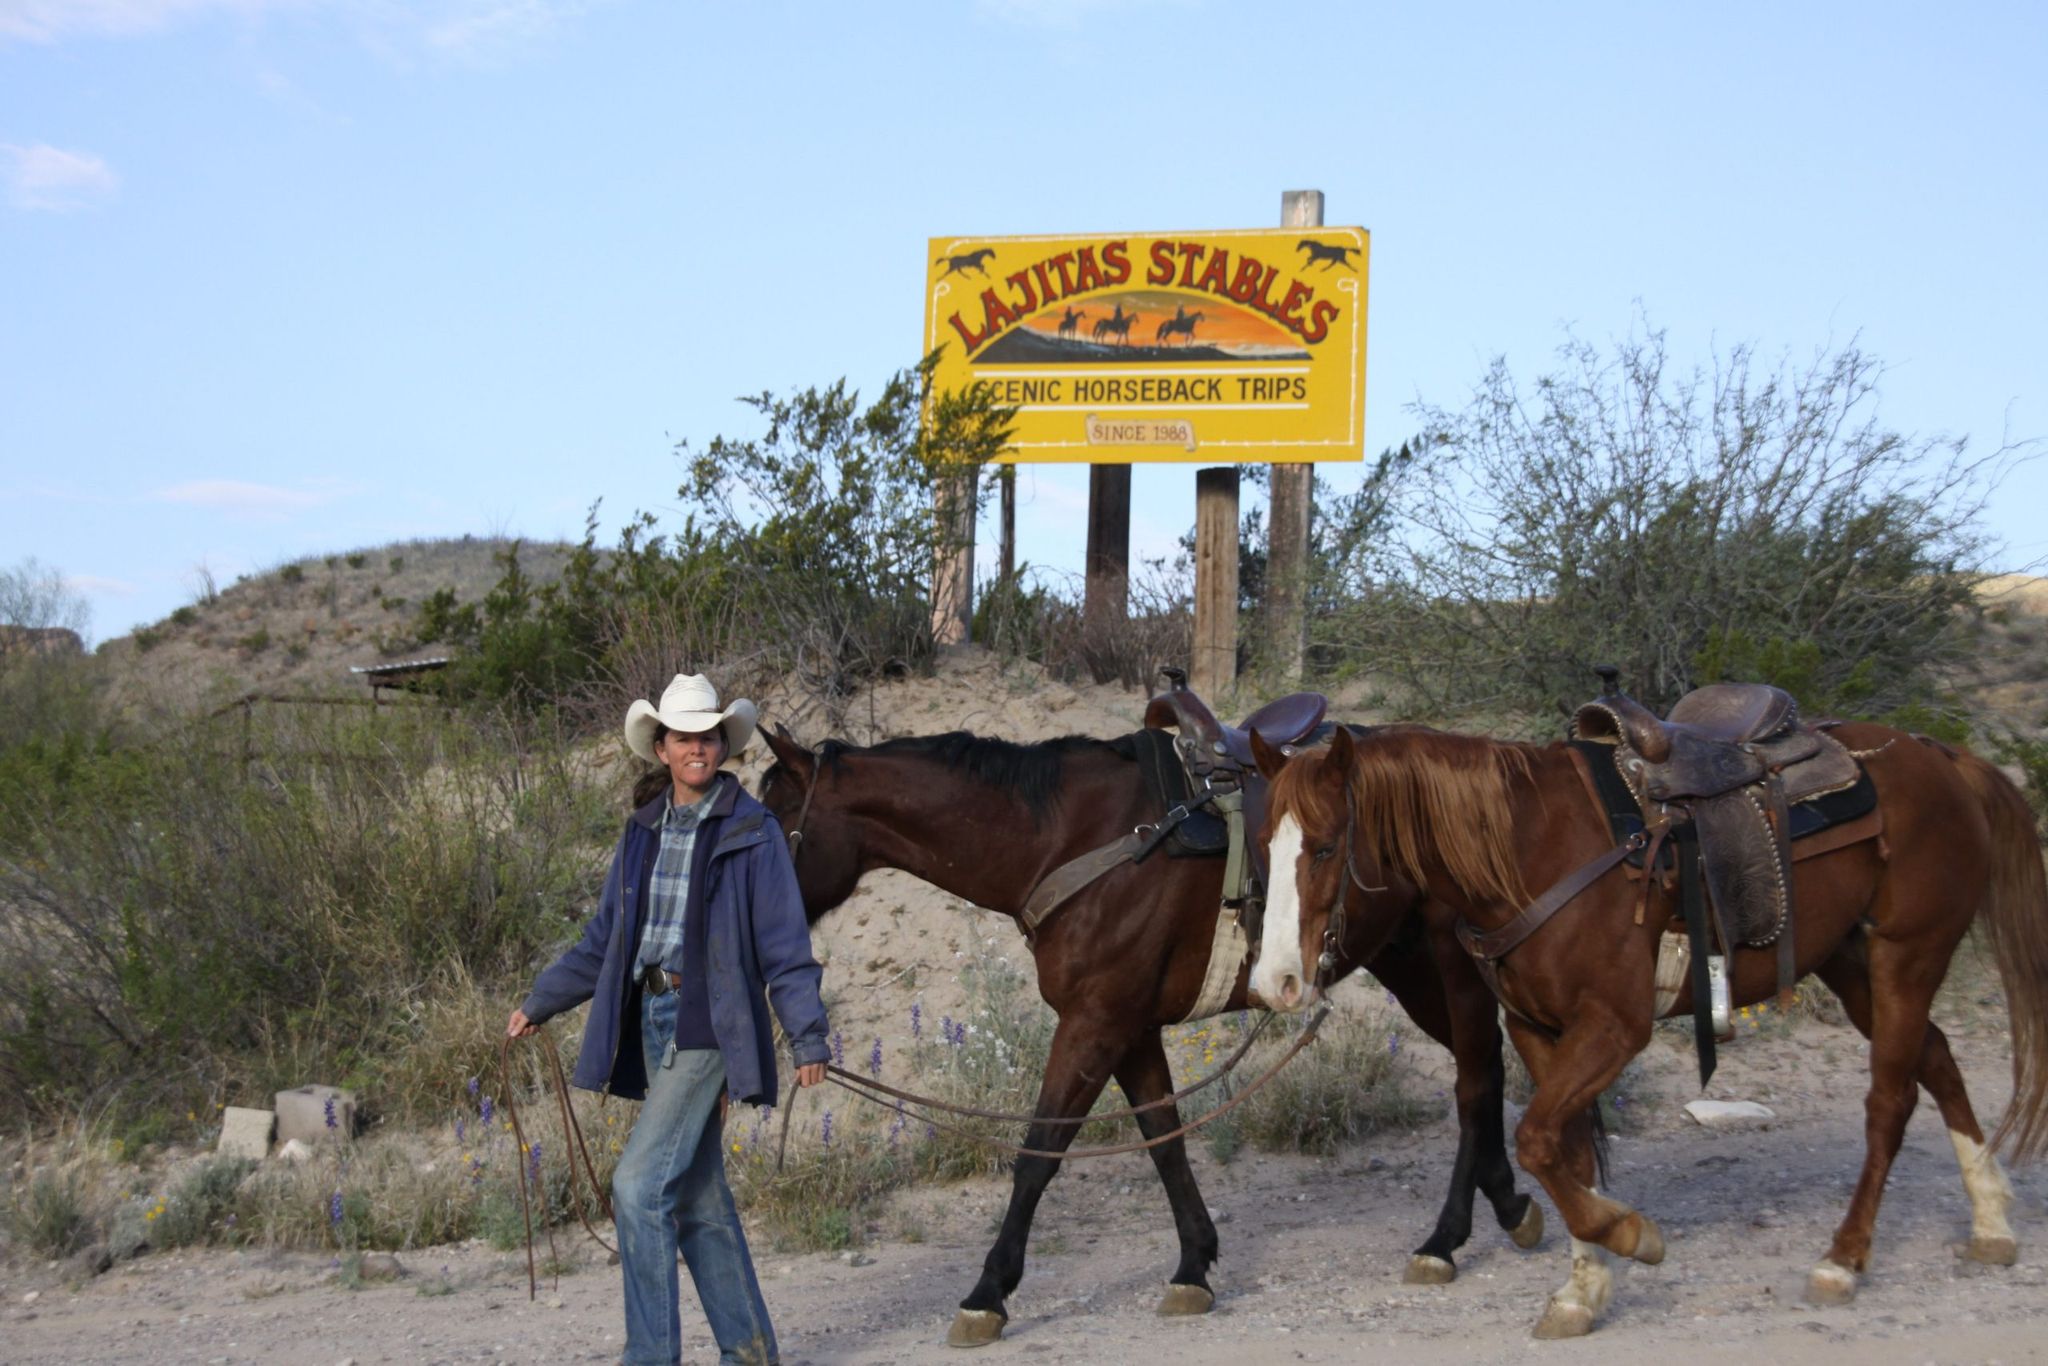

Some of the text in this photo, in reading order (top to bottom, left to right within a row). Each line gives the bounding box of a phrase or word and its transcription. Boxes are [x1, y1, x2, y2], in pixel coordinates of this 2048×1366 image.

[948, 240, 1340, 356] LAJITAS STABLES
[1074, 378, 1222, 402] HORSEBACK
[1237, 377, 1307, 401] TRIPS
[1092, 425, 1188, 441] SINCE 1988
